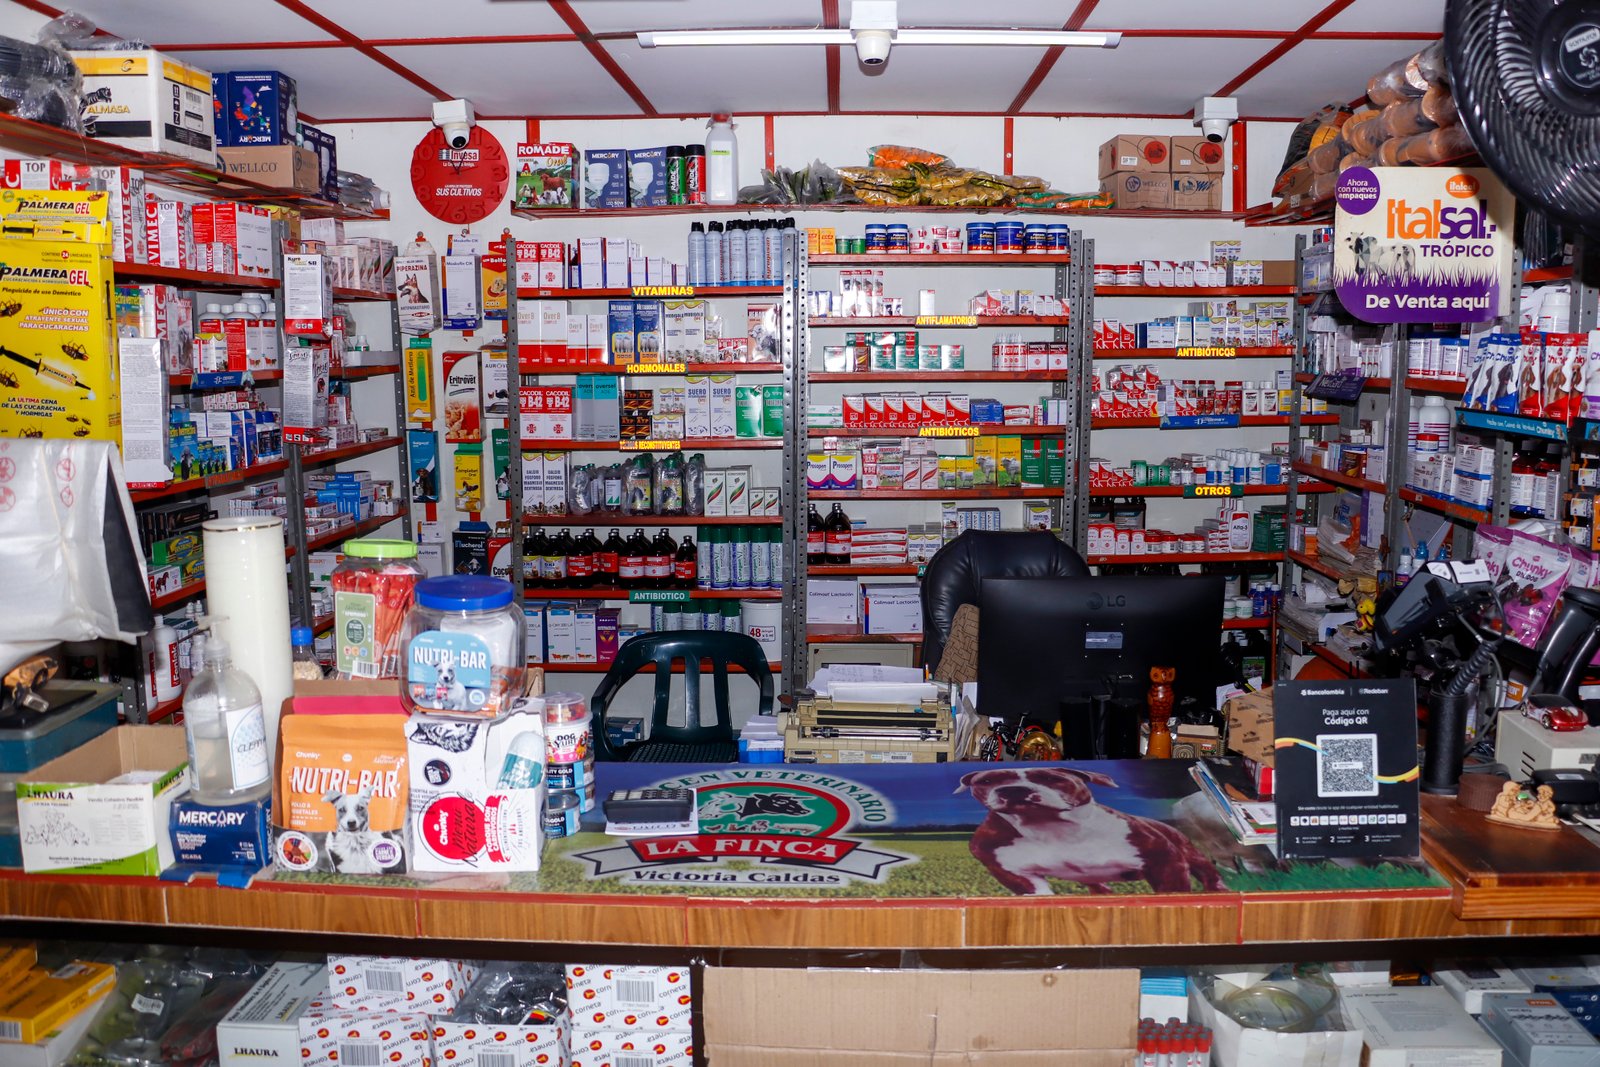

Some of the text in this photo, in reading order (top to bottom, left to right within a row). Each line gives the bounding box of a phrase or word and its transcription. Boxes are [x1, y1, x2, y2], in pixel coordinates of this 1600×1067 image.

[451, 149, 478, 161] Invesa
[518, 145, 570, 155] ROMADE
[25, 162, 46, 172] TOP
[230, 162, 277, 173] WELLCO
[522, 163, 532, 172] A
[436, 188, 482, 196] SUS CULTIVOS
[1338, 192, 1377, 200] empaques
[16, 201, 90, 214] PALMERA GEL
[121, 180, 132, 248] VIMEC
[147, 207, 159, 260] VIMEC
[1420, 241, 1494, 258] TRÓPICO
[396, 264, 428, 272] PIPERAZINA
[0, 267, 90, 285] PALMERA GEL
[632, 286, 694, 296] VITAMINAS
[1366, 292, 1490, 312] De Venta aquí
[157, 294, 168, 339] MEC
[916, 316, 978, 326] ANTIFLAMATORIOS
[626, 364, 686, 373] HORMONALES
[449, 376, 476, 384] Eritrovet
[919, 426, 980, 436] ANTIBIÓTICOS
[1194, 486, 1232, 496] OTROS
[1512, 556, 1553, 580] Chunky
[1107, 596, 1126, 608] LG
[750, 628, 761, 638] 48
[414, 646, 486, 670] NUTRI-BAR
[1322, 708, 1339, 719] Paga
[1340, 708, 1356, 717] aquí
[1324, 716, 1368, 727] Código QR
[296, 752, 320, 760] Chunky
[292, 766, 398, 800] NUTRI-BAR
[26, 790, 74, 800] LHAURA
[658, 770, 888, 822] CEN VETERINARIO
[440, 810, 448, 846] Chunky
[647, 838, 838, 858] LA FINCA
[634, 870, 840, 884] Victoria Caldas
[658, 984, 687, 998] corneta
[575, 1002, 602, 1015] corneta
[234, 1048, 279, 1057] LHAURA
[657, 1052, 684, 1065] corneta
